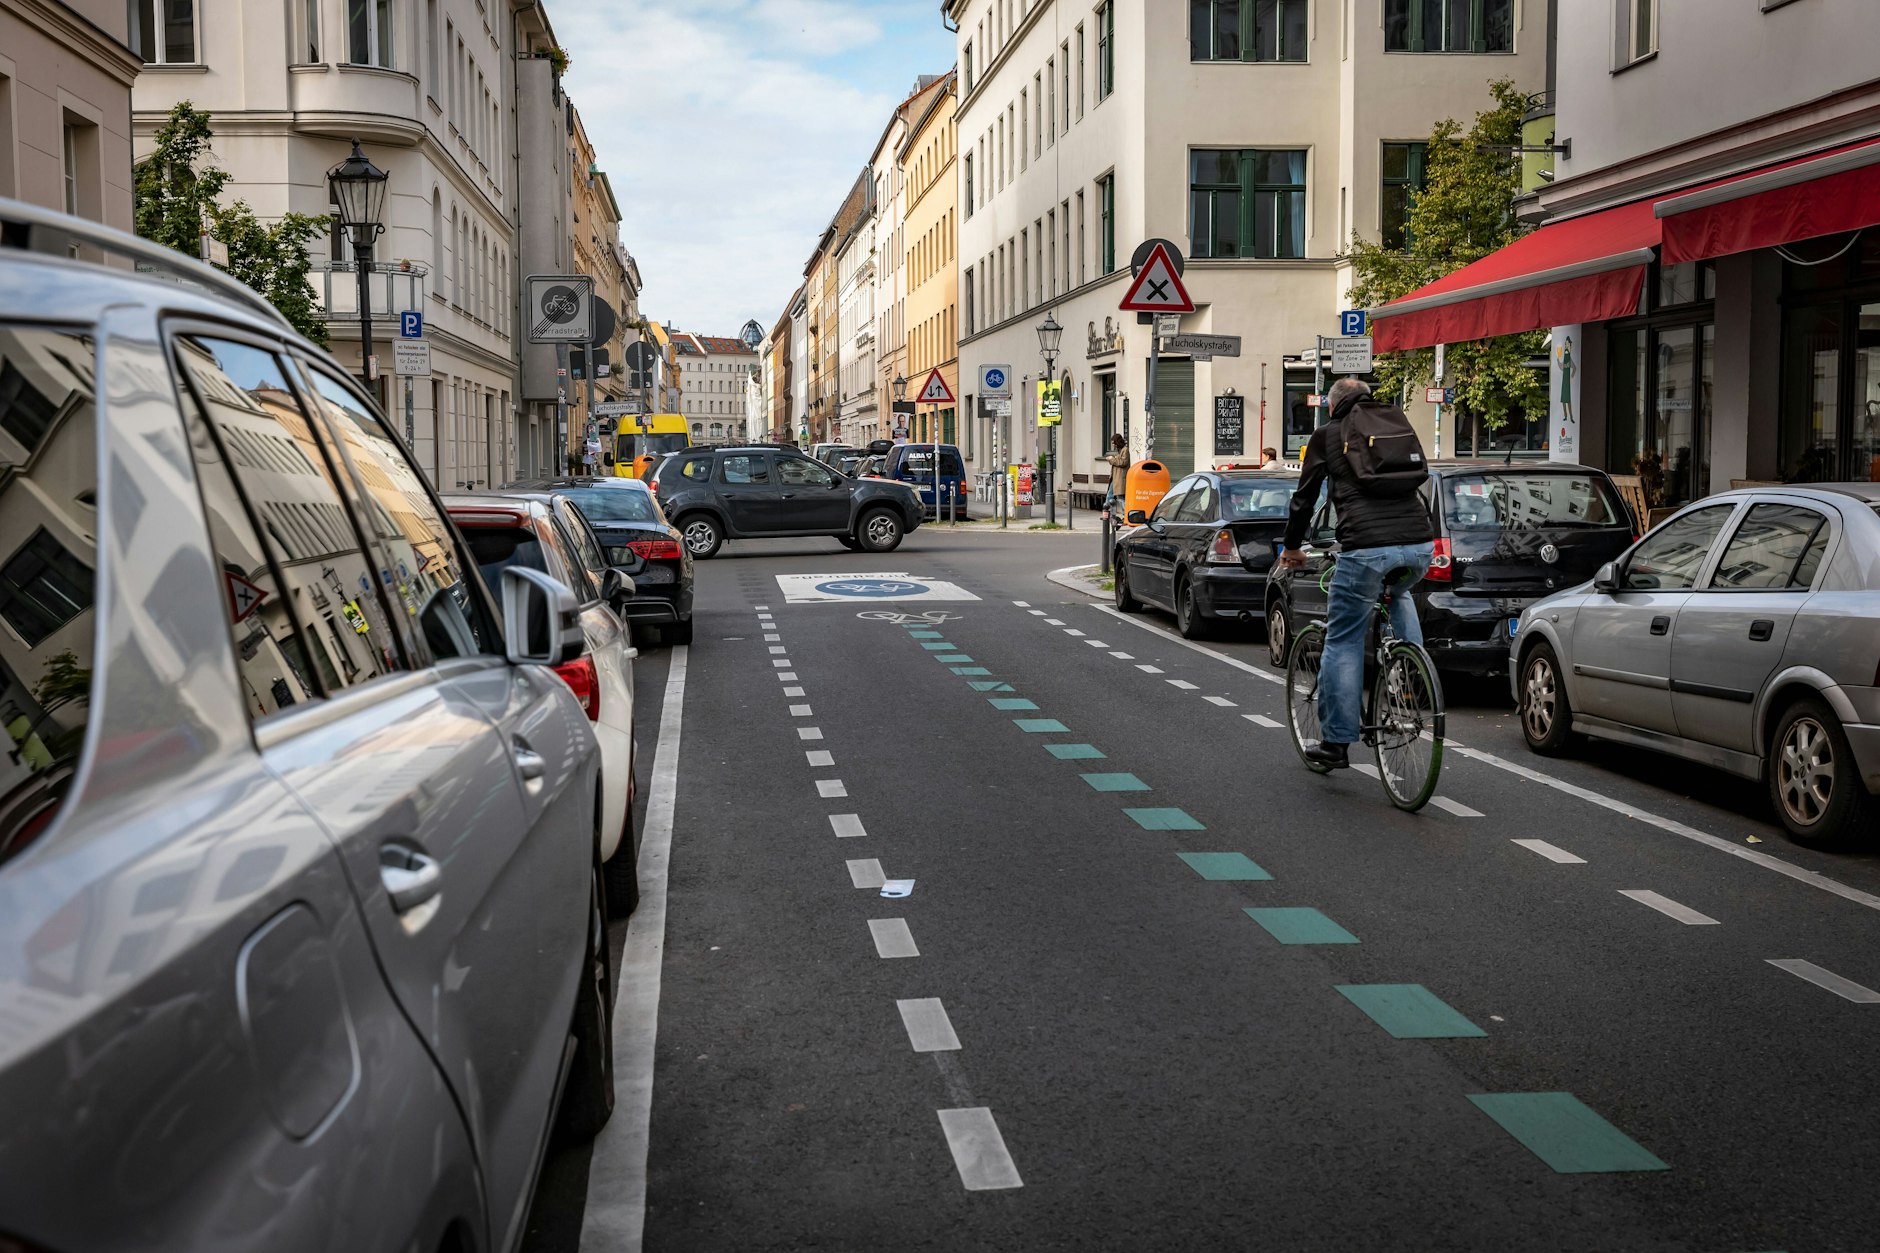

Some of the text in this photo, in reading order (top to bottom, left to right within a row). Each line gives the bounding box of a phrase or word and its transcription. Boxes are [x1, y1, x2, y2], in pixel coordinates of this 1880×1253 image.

[405, 315, 417, 334] P
[1346, 314, 1360, 333] P
[1171, 339, 1232, 352] Tucholskystraße
